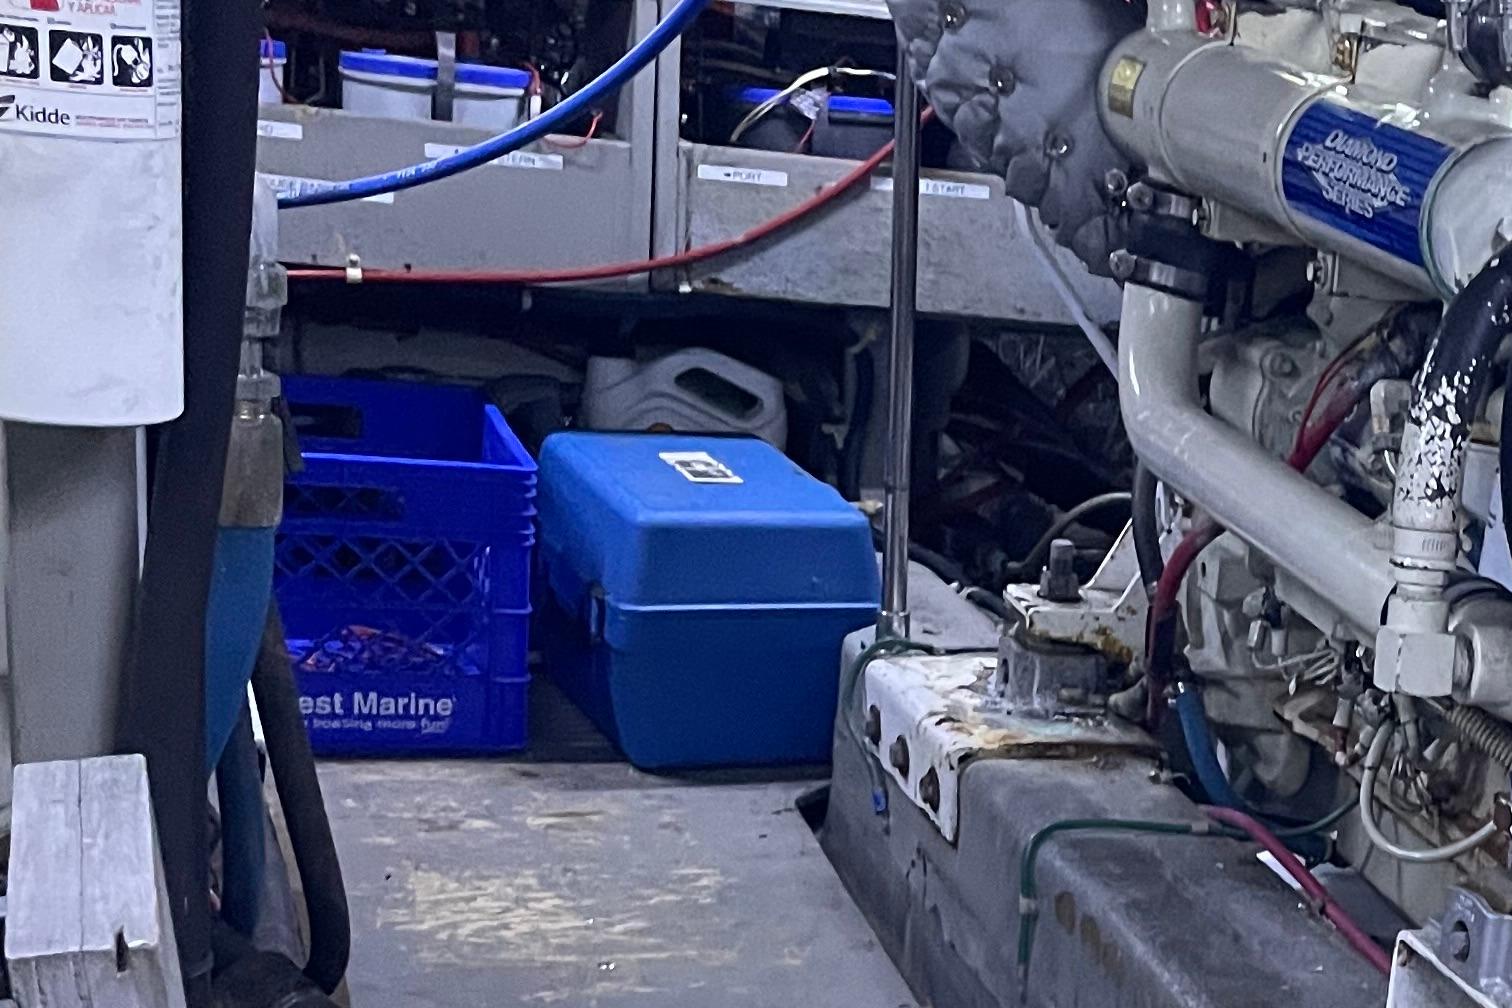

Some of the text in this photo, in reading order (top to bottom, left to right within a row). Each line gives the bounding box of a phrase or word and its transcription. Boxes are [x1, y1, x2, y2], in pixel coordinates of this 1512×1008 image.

[15, 104, 70, 125] Kidde
[1324, 128, 1399, 172] DIAMOND
[1297, 141, 1411, 206] PERFORMANCE
[1322, 183, 1374, 219] SERIES
[299, 691, 453, 716] est Marine
